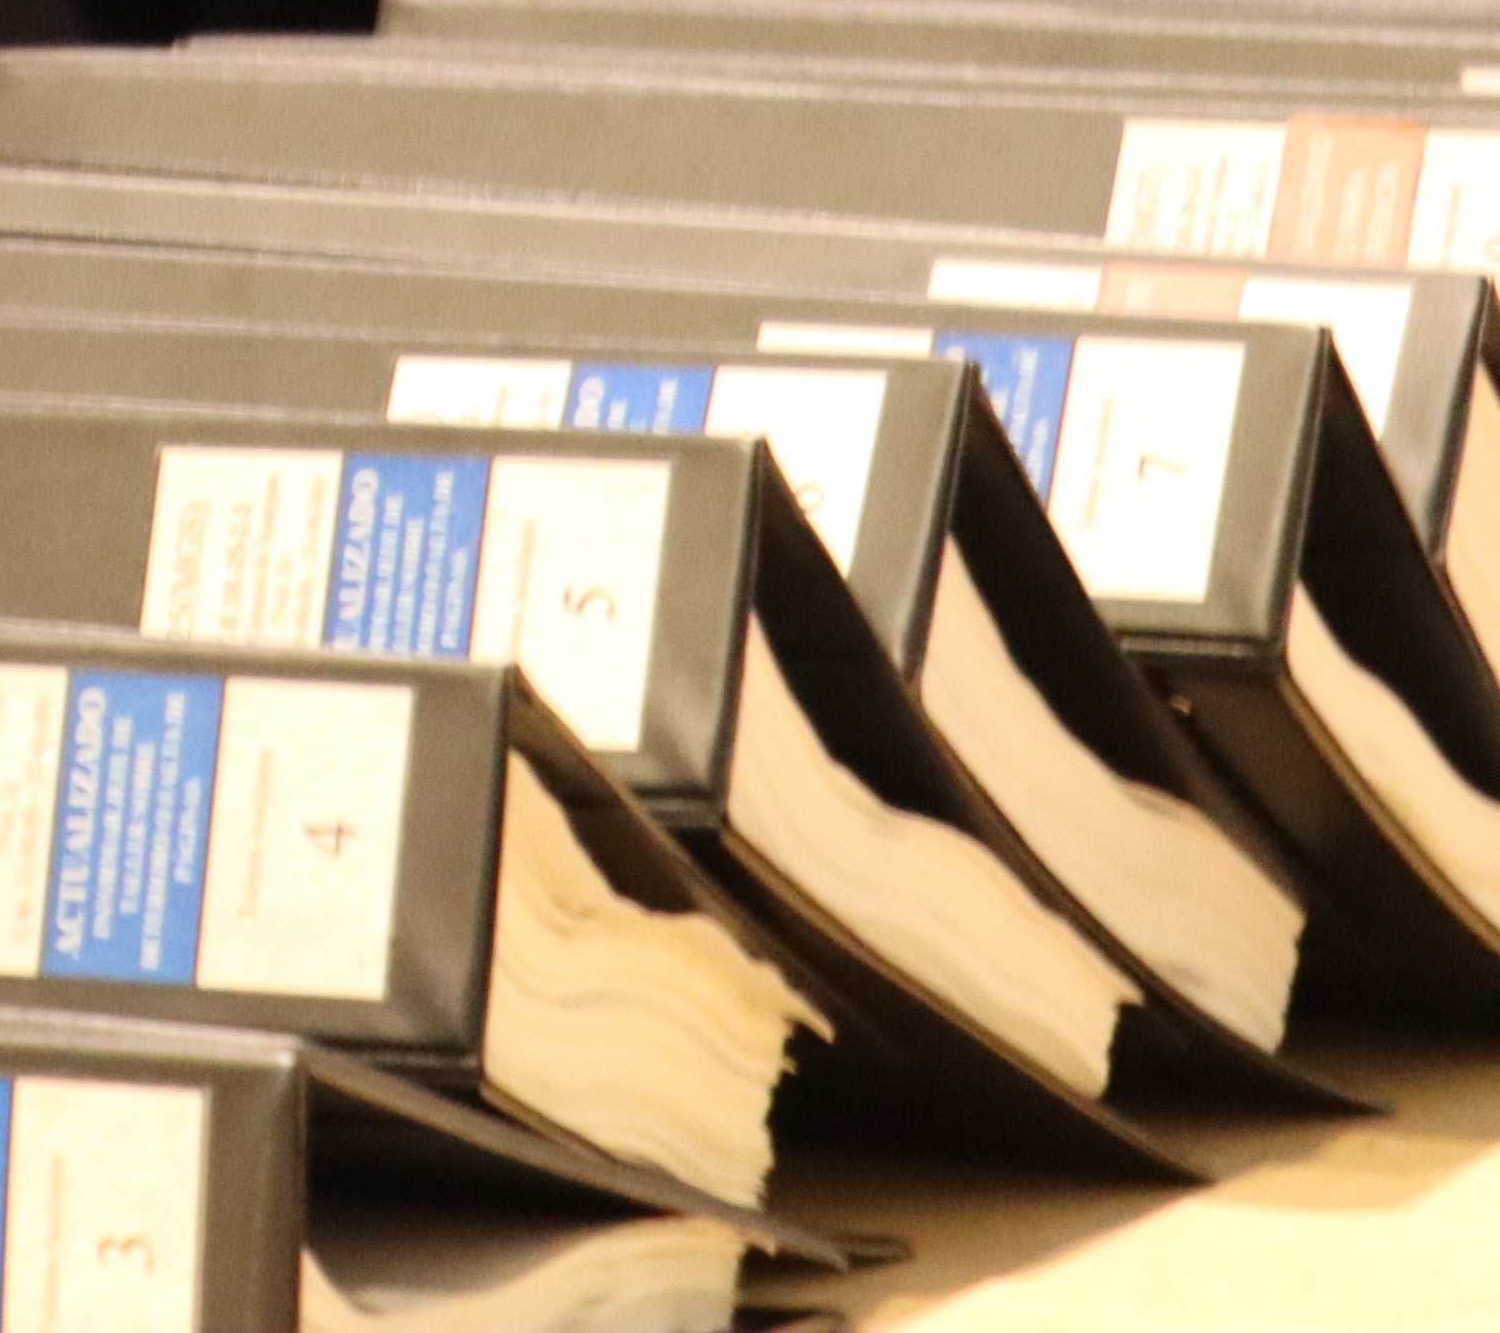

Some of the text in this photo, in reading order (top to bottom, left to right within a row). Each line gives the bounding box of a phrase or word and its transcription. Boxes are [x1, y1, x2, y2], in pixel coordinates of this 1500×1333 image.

[1137, 453, 1189, 480] 7
[559, 585, 616, 622] 5
[51, 685, 107, 958] ACTUALIZADO
[298, 817, 357, 861] 4
[95, 1232, 155, 1275] 3
